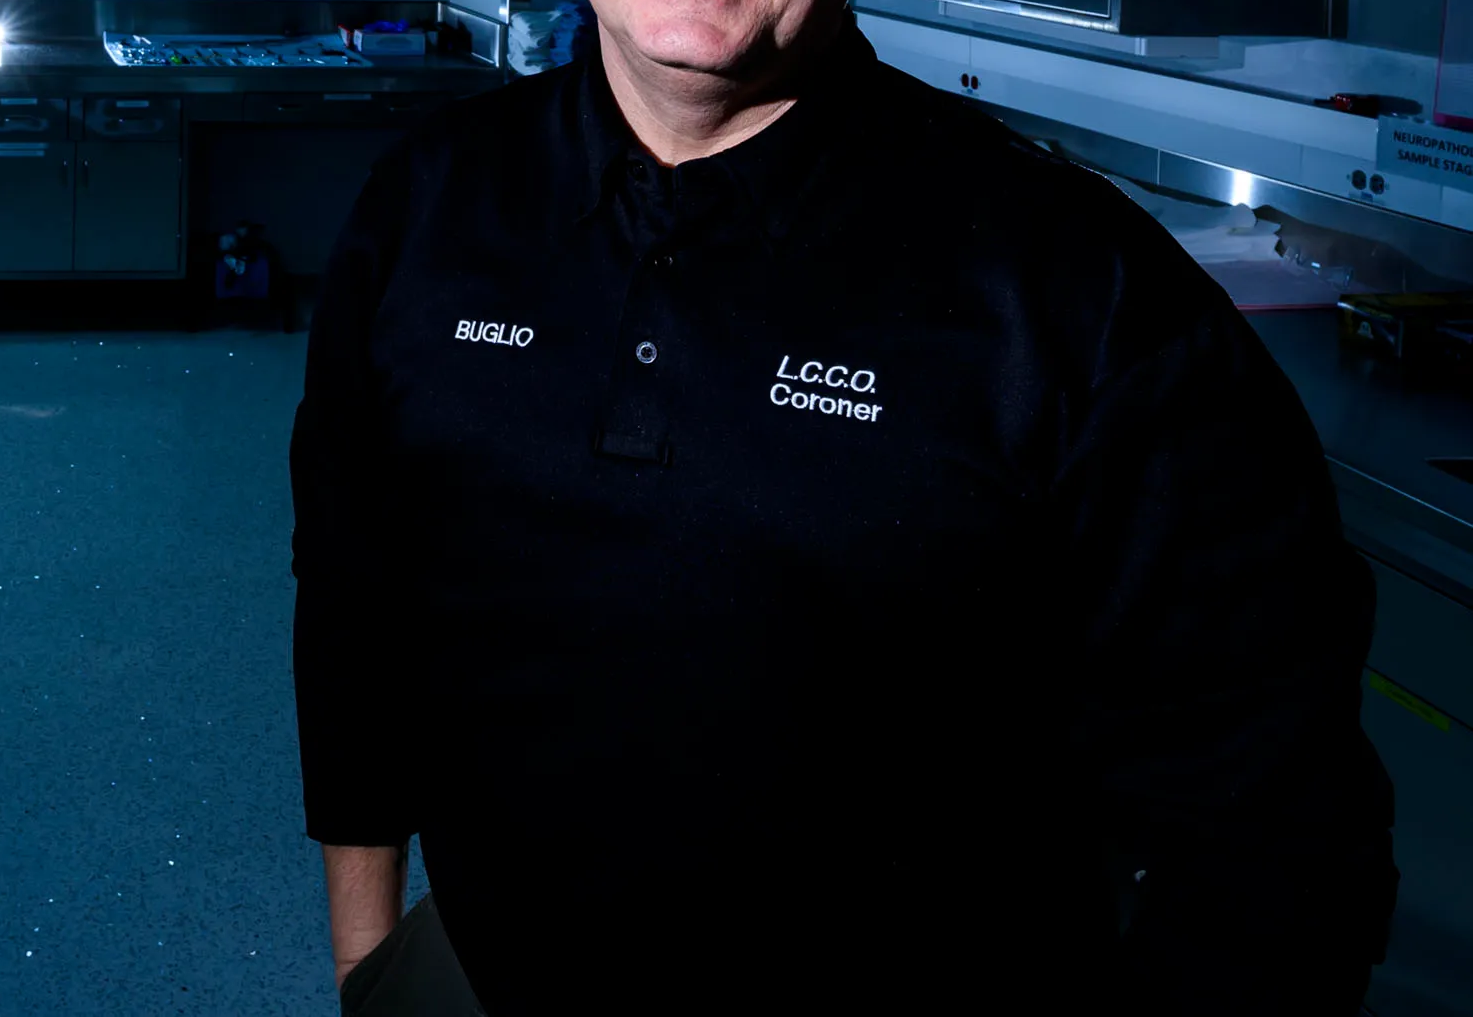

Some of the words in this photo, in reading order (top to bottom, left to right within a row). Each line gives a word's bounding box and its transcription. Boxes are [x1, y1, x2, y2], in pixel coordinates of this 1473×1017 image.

[1397, 148, 1440, 169] SAMPLE
[1442, 158, 1473, 176] STAG
[454, 319, 534, 348] BUGLIO
[775, 354, 877, 394] L.C.C.O.
[769, 382, 883, 423] Coroner
